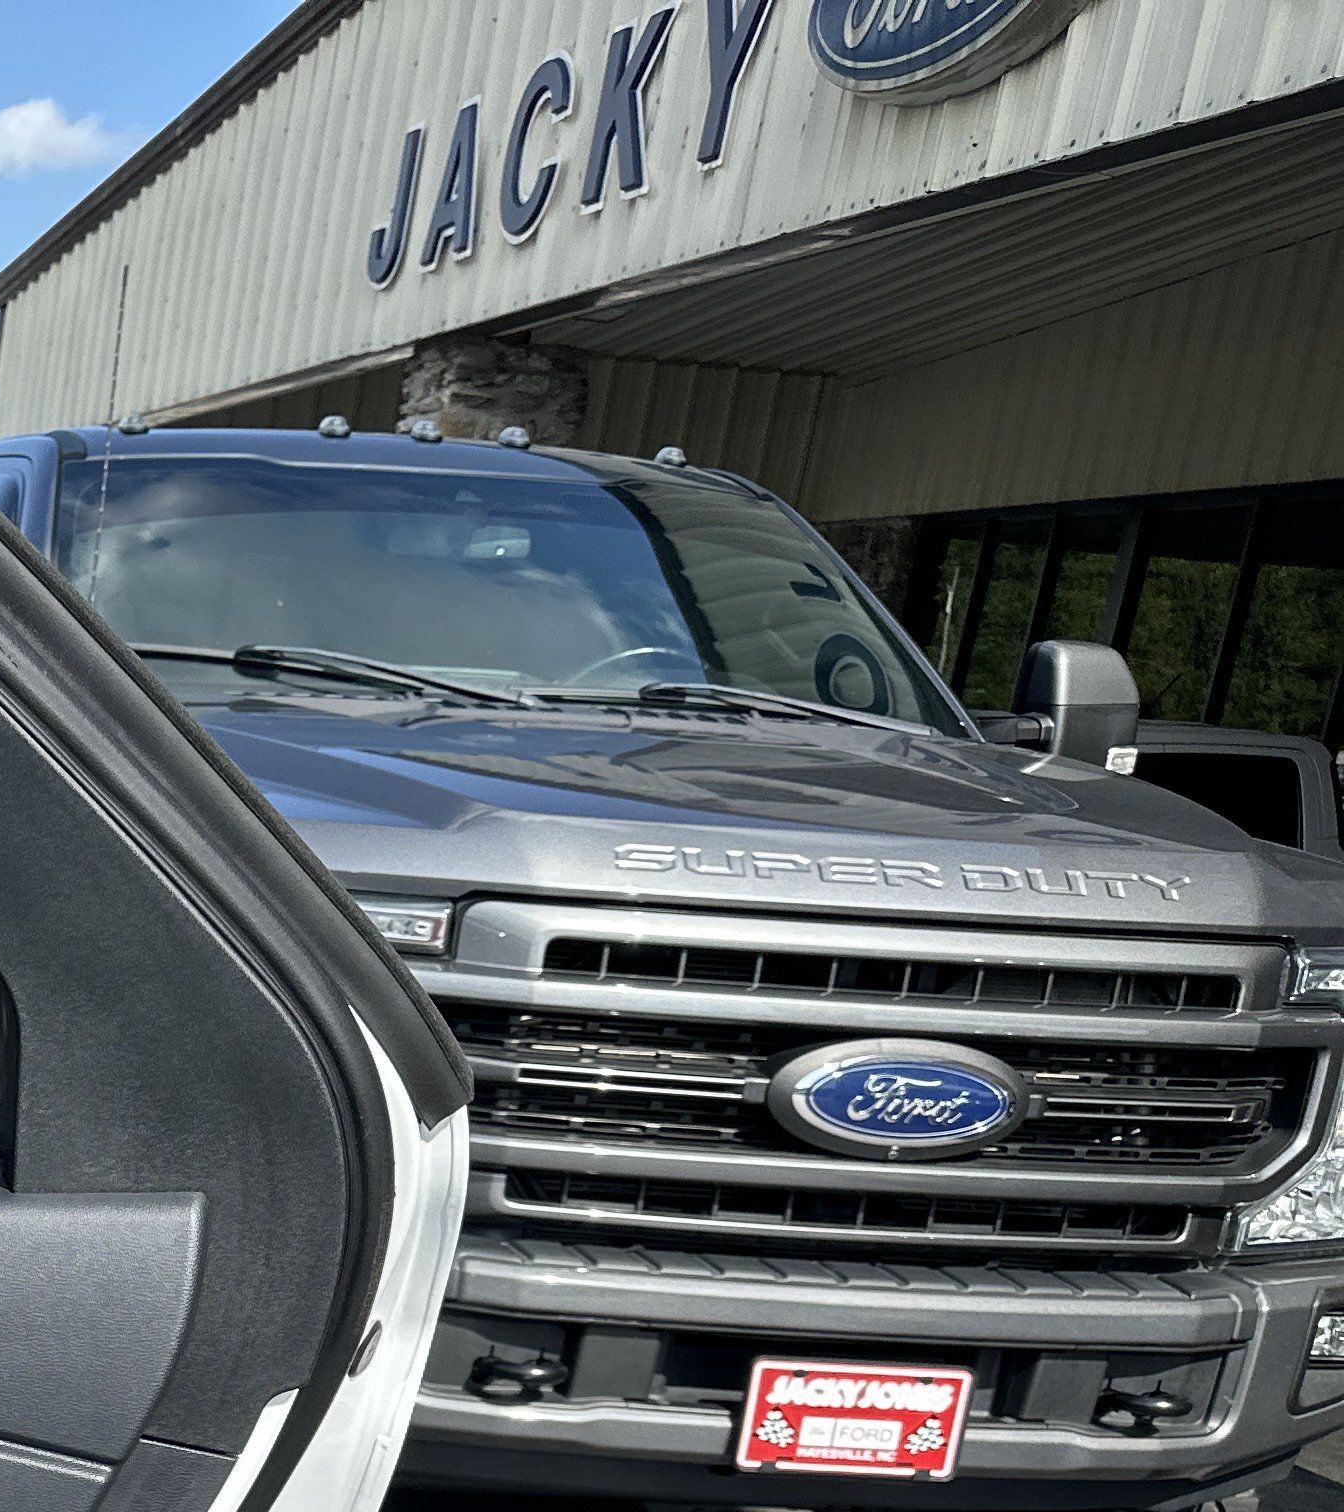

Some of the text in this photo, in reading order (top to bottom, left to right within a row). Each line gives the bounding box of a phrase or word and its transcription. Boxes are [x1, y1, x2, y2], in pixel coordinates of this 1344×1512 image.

[367, 0, 775, 291] JACKY
[614, 843, 1192, 901] SUPER DUTY
[847, 1074, 970, 1125] Ford
[765, 1375, 955, 1414] JACKY JONES
[839, 1425, 894, 1443] FORD
